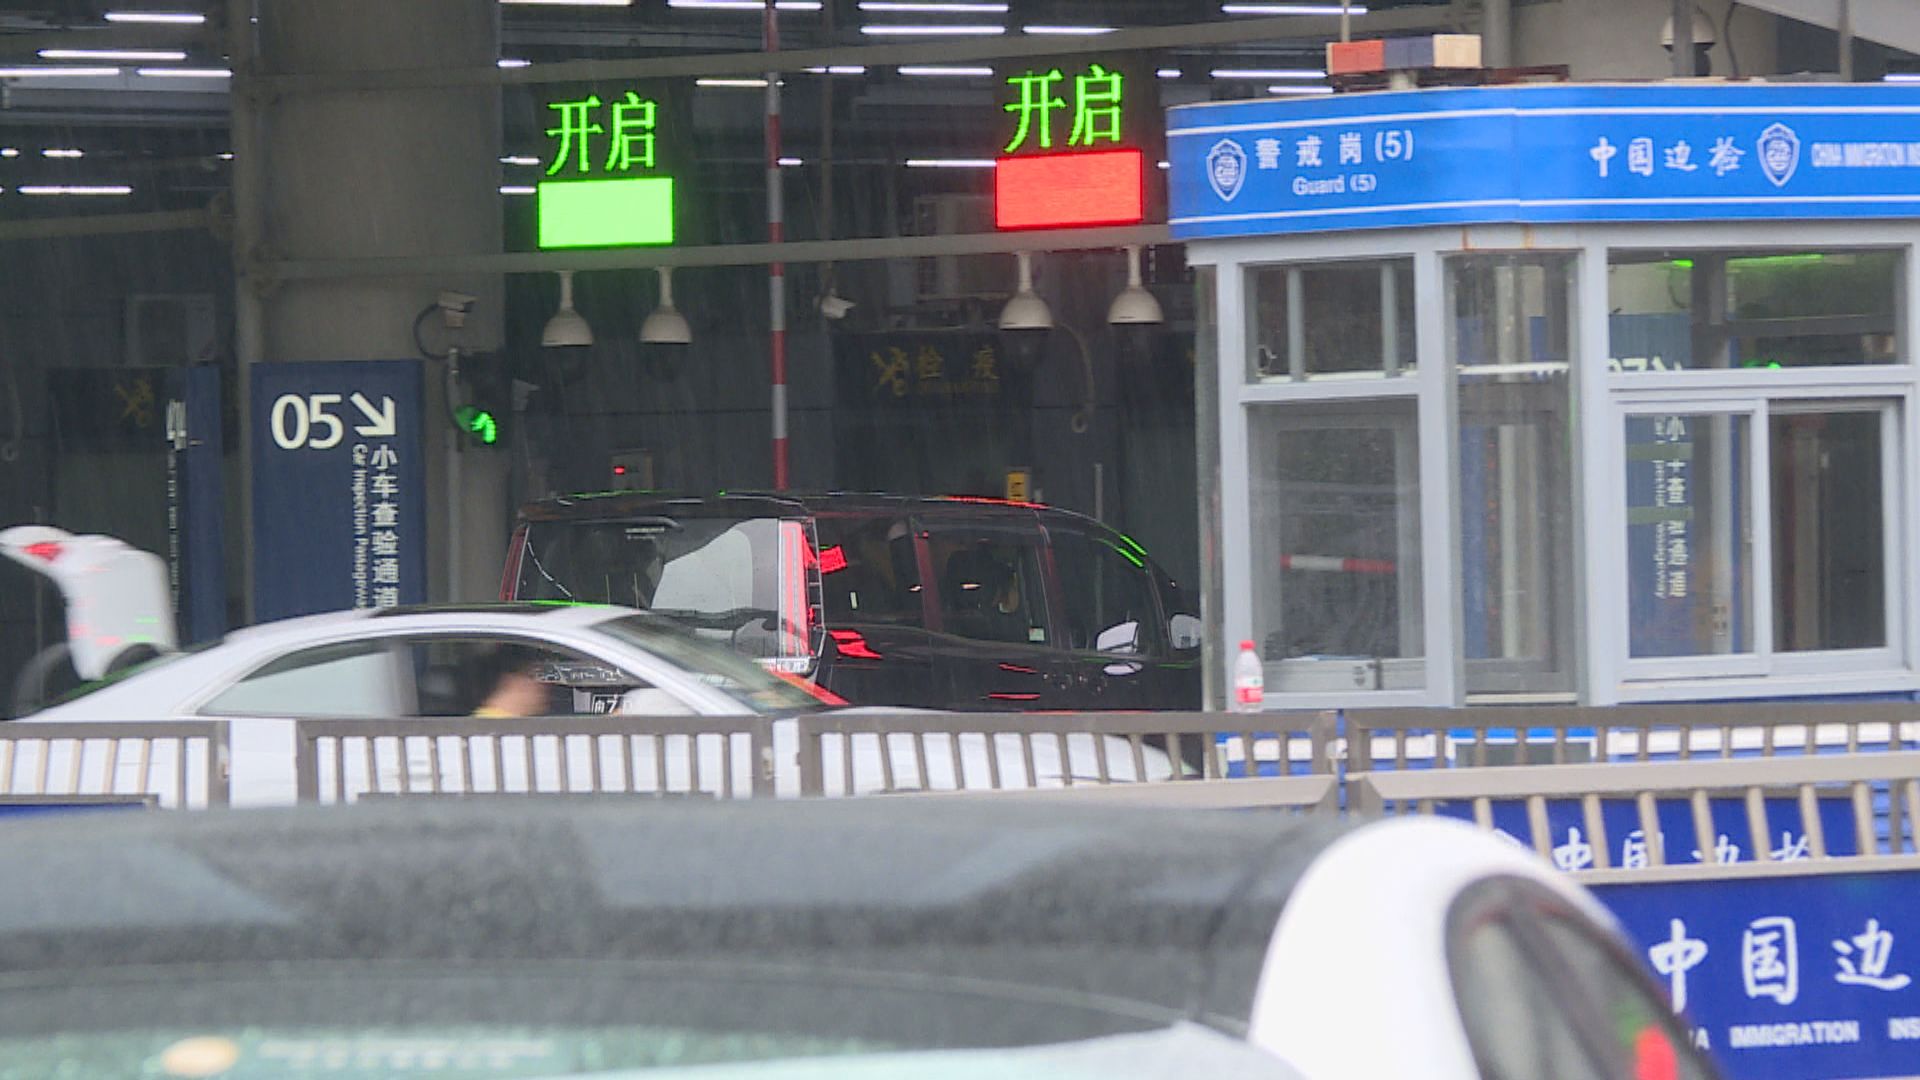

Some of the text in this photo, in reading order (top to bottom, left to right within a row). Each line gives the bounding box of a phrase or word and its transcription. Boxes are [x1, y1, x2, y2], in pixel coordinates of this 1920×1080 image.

[546, 91, 656, 175] 开启
[1004, 63, 1122, 152] 开启
[1293, 174, 1377, 195] Guard (5)
[1589, 136, 1746, 177] 中国边检
[271, 393, 344, 449] 05
[352, 444, 368, 466] Car
[352, 469, 368, 535] Inspection
[370, 444, 400, 609] 小车查验通道
[1648, 916, 1912, 1014] 中国边
[1729, 1019, 1860, 1049] IMMIGRATION
